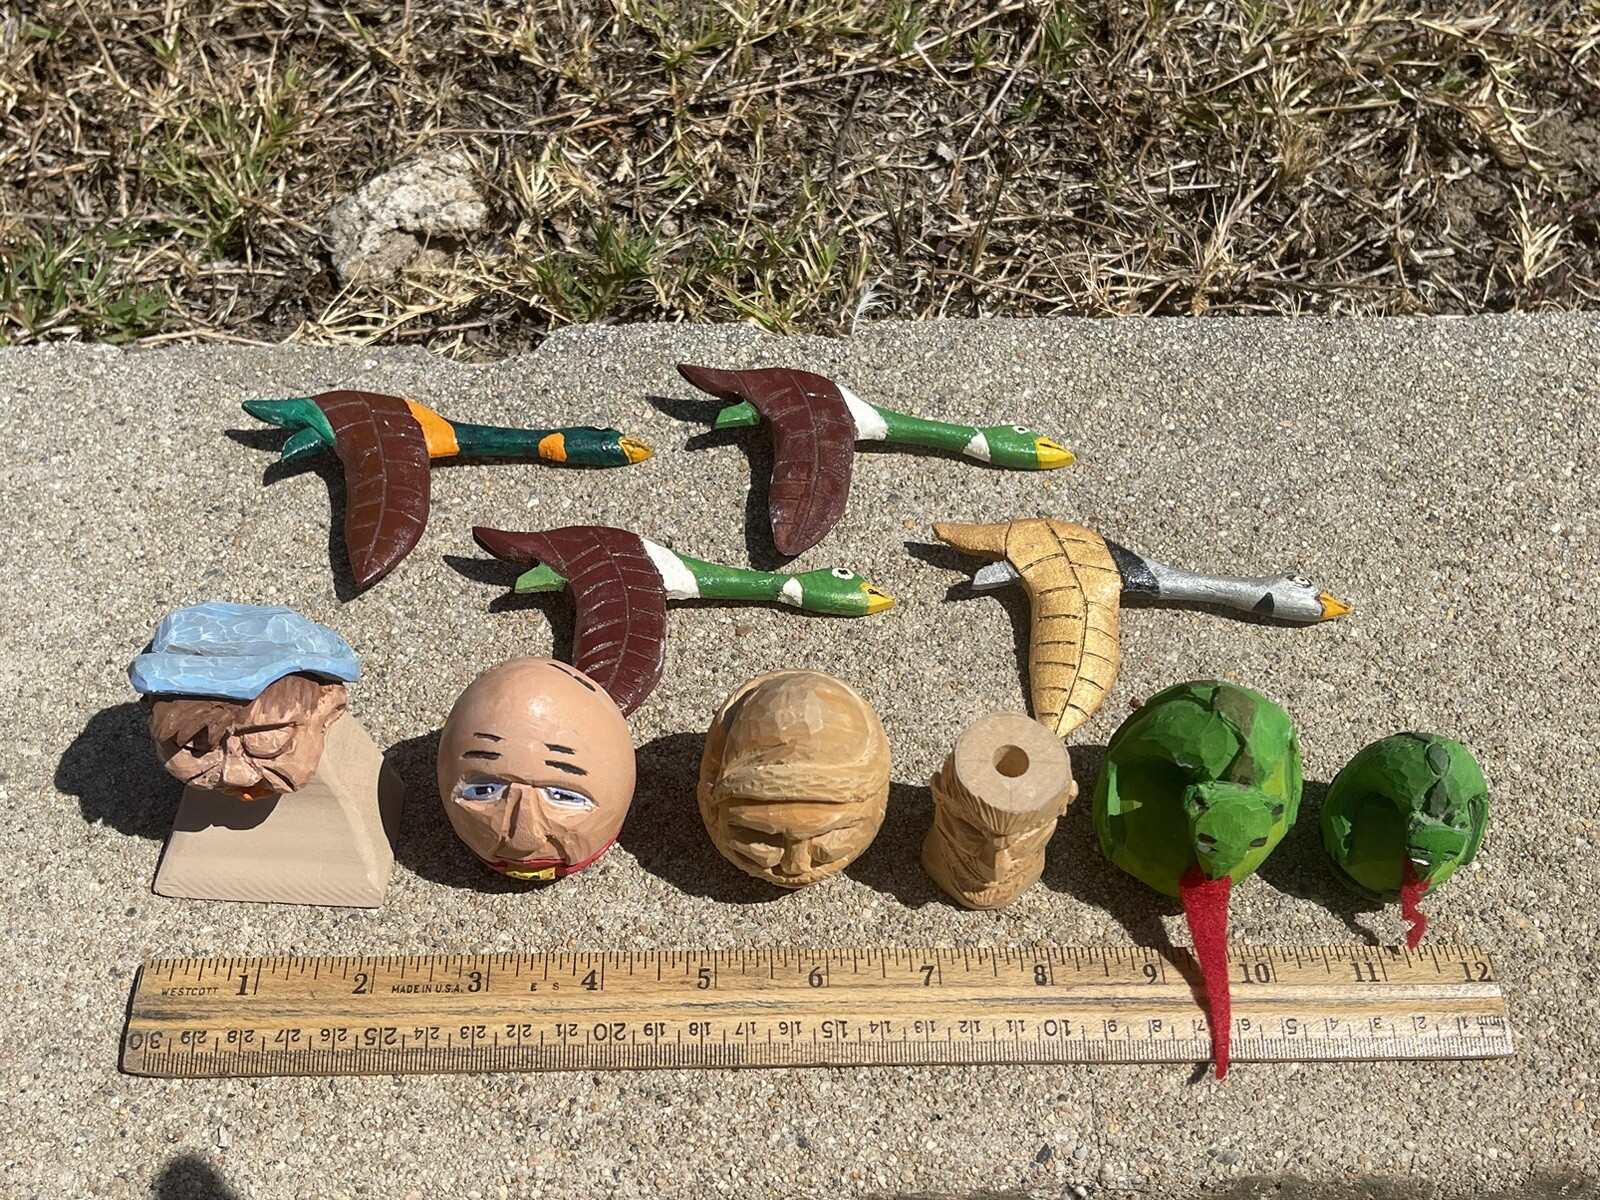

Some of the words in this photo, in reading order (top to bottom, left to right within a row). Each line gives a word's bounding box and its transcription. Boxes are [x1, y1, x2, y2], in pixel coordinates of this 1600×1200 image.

[235, 974, 249, 996] 1
[352, 973, 368, 995] 2
[467, 971, 482, 992] 3
[581, 969, 598, 991] 4
[697, 968, 711, 990] 5
[808, 966, 824, 988] 6
[919, 965, 935, 986] 7
[1033, 965, 1047, 986] 8
[1142, 964, 1157, 984] 9
[1239, 962, 1270, 984] 10
[1351, 961, 1380, 983] 11
[1459, 961, 1492, 983] 12
[161, 987, 219, 996] WESTCOTT
[391, 985, 421, 994] MADE
[422, 985, 432, 993] IN
[435, 984, 464, 993] U.S.A.
[644, 1022, 666, 1036] 19
[689, 1022, 711, 1036] 18
[735, 1021, 757, 1035] 17
[779, 1021, 801, 1035] 16
[821, 1021, 848, 1038] 15
[869, 1020, 892, 1033] 14
[914, 1020, 936, 1033] 13
[958, 1020, 981, 1033] 12
[1006, 1019, 1026, 1032] 11
[1044, 1019, 1072, 1037] 10
[1107, 1020, 1118, 1032] 9
[1152, 1019, 1163, 1032] 8
[1197, 1019, 1207, 1031] 7
[1240, 1018, 1251, 1031] 6
[1285, 1018, 1298, 1035] 5
[1329, 1017, 1339, 1030] 4
[1372, 1017, 1382, 1029] 3
[1417, 1016, 1427, 1029] 2
[1461, 1016, 1470, 1029] 1
[180, 1030, 208, 1044] 29
[227, 1029, 255, 1043] 28
[274, 1029, 301, 1042] 27
[320, 1028, 348, 1042] 26
[364, 1027, 397, 1046] 25
[413, 1026, 440, 1040] 24
[460, 1025, 486, 1039] 23
[506, 1024, 532, 1038] 22
[556, 1023, 578, 1037] 21
[593, 1023, 627, 1041] 20
[128, 1030, 163, 1049] 30
